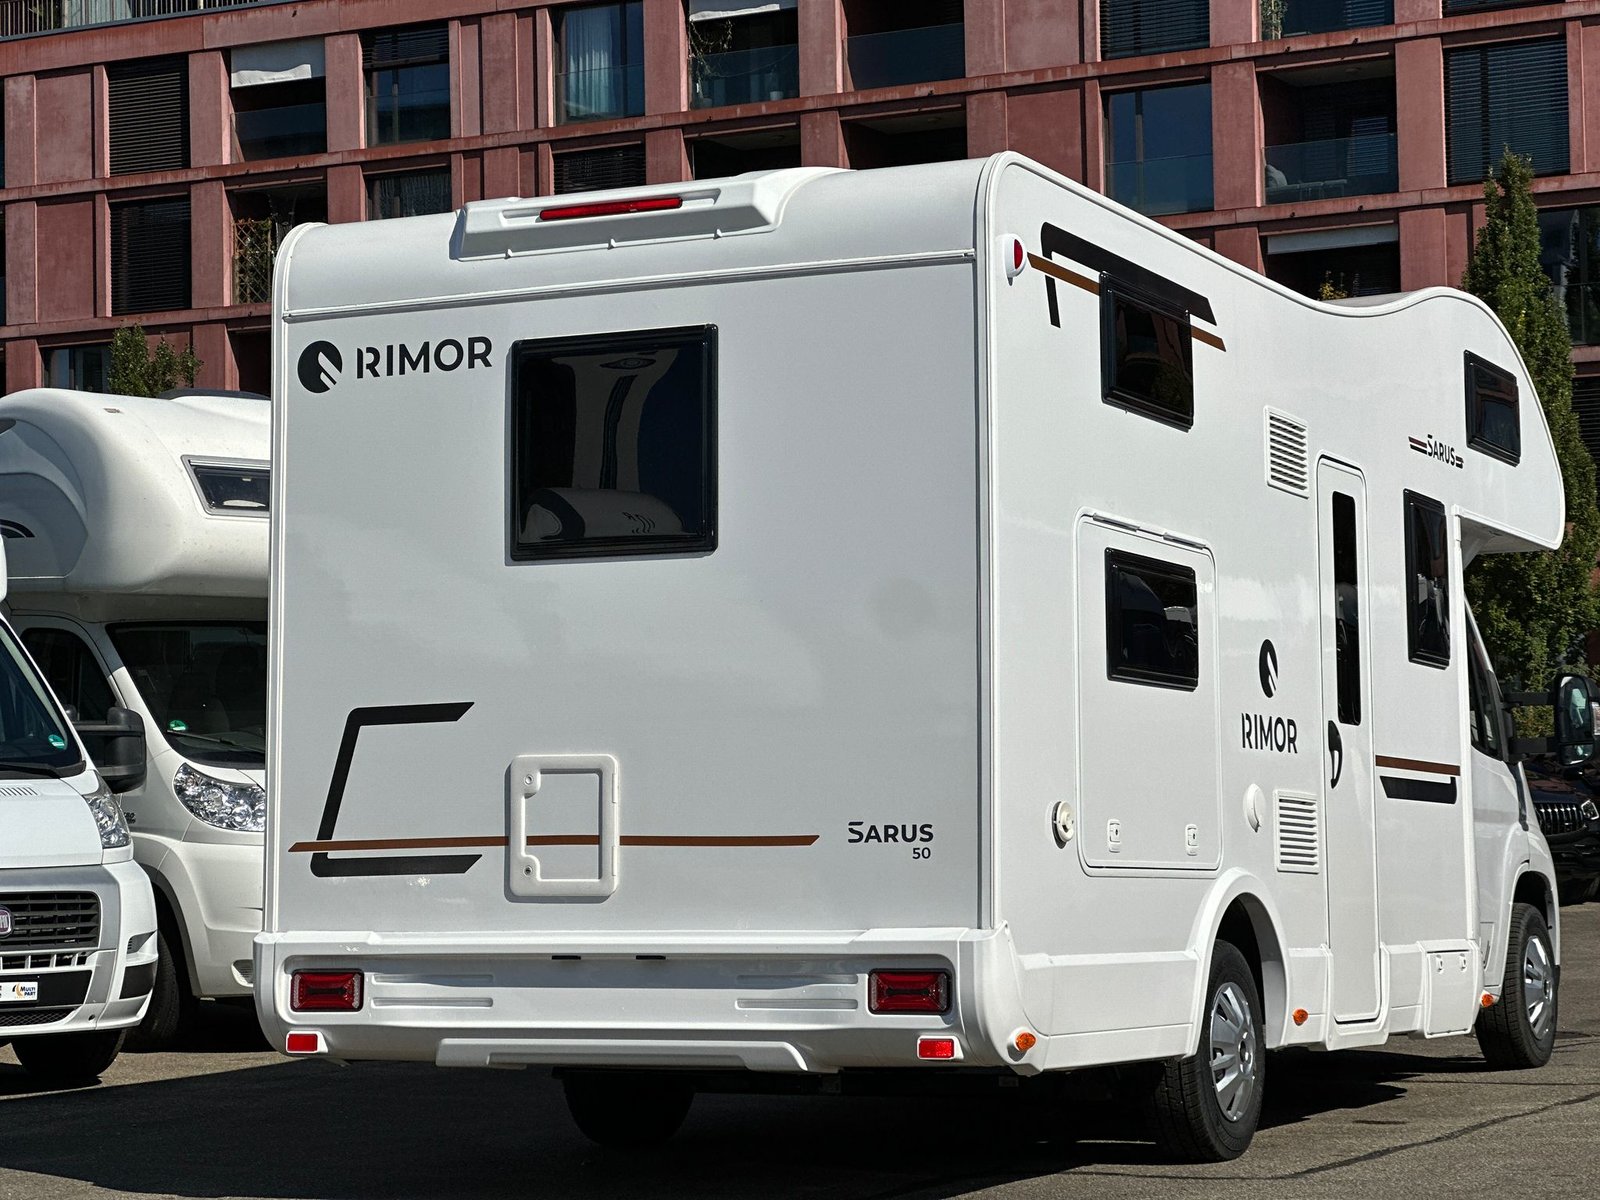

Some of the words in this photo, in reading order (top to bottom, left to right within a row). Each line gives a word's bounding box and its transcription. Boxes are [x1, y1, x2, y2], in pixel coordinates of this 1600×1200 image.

[357, 336, 492, 379] RIMOR
[1427, 434, 1455, 466] SARUS
[1241, 712, 1298, 754] RIMOR
[848, 821, 934, 843] SARUS
[912, 847, 931, 859] 50
